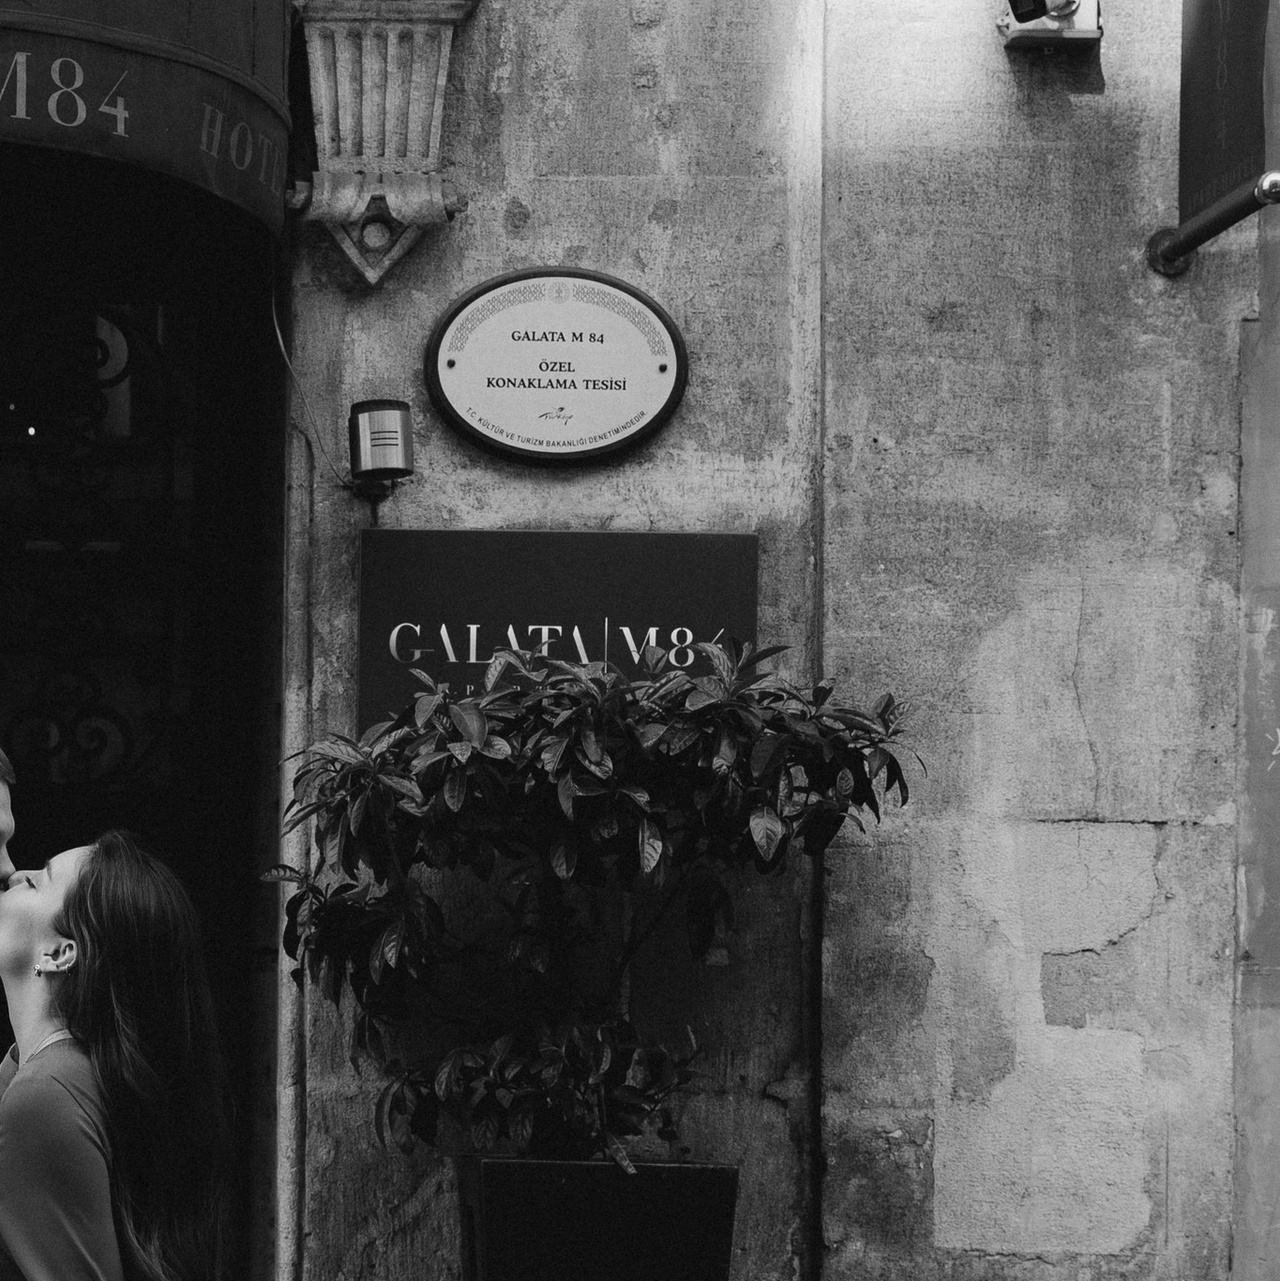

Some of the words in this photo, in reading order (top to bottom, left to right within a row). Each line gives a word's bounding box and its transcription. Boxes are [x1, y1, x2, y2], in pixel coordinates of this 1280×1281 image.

[511, 330, 566, 342] GALATA
[571, 332, 583, 342] M
[588, 333, 605, 344] 84
[538, 358, 575, 372] ÖZEL
[486, 377, 577, 390] KONAKLAMA
[582, 377, 627, 391] TESİSİ
[478, 417, 505, 437] KÜLTÜR
[505, 431, 516, 441] VE
[517, 435, 544, 446] TURİZM
[545, 438, 587, 447] BAKANLIĞI
